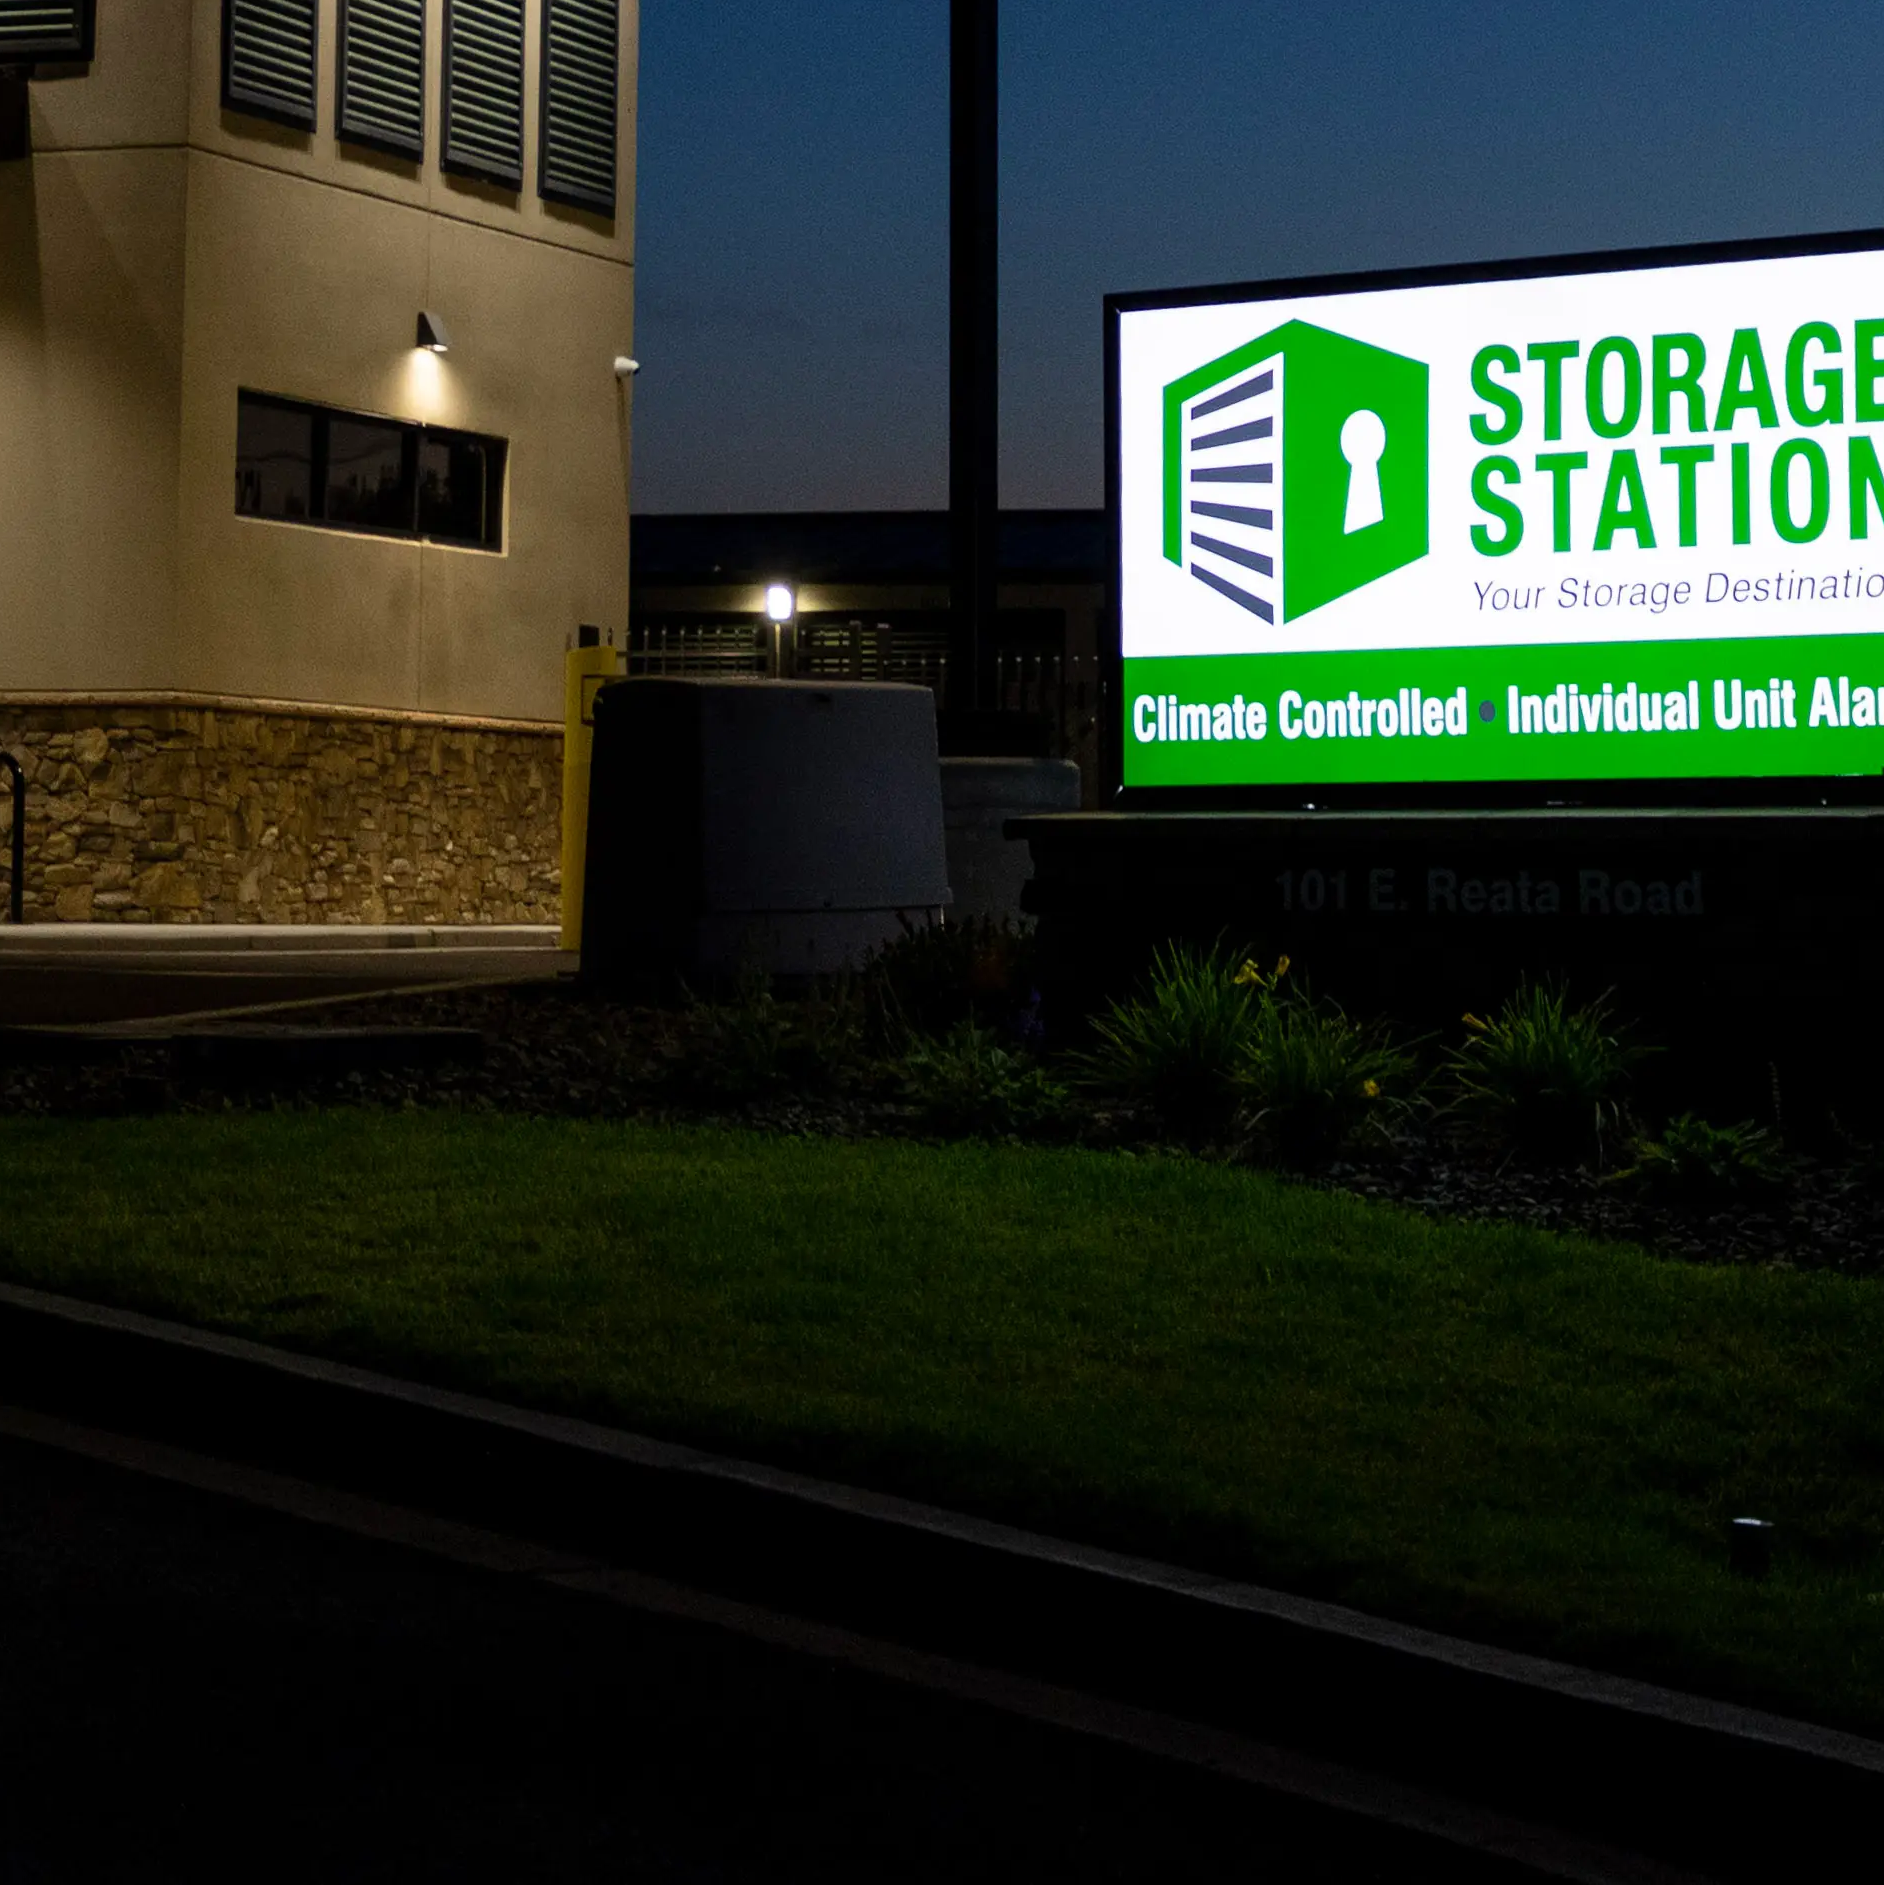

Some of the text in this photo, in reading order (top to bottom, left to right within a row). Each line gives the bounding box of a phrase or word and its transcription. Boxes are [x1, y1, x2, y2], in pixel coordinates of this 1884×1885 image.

[1473, 580, 1546, 611] Your
[1557, 575, 1692, 614] Storage
[1133, 694, 1267, 743] Climate
[1278, 686, 1468, 740] Controlled
[1507, 680, 1700, 734] Individual
[1713, 677, 1797, 731] Unit
[1274, 865, 1705, 916] 101 E. Reata Road
